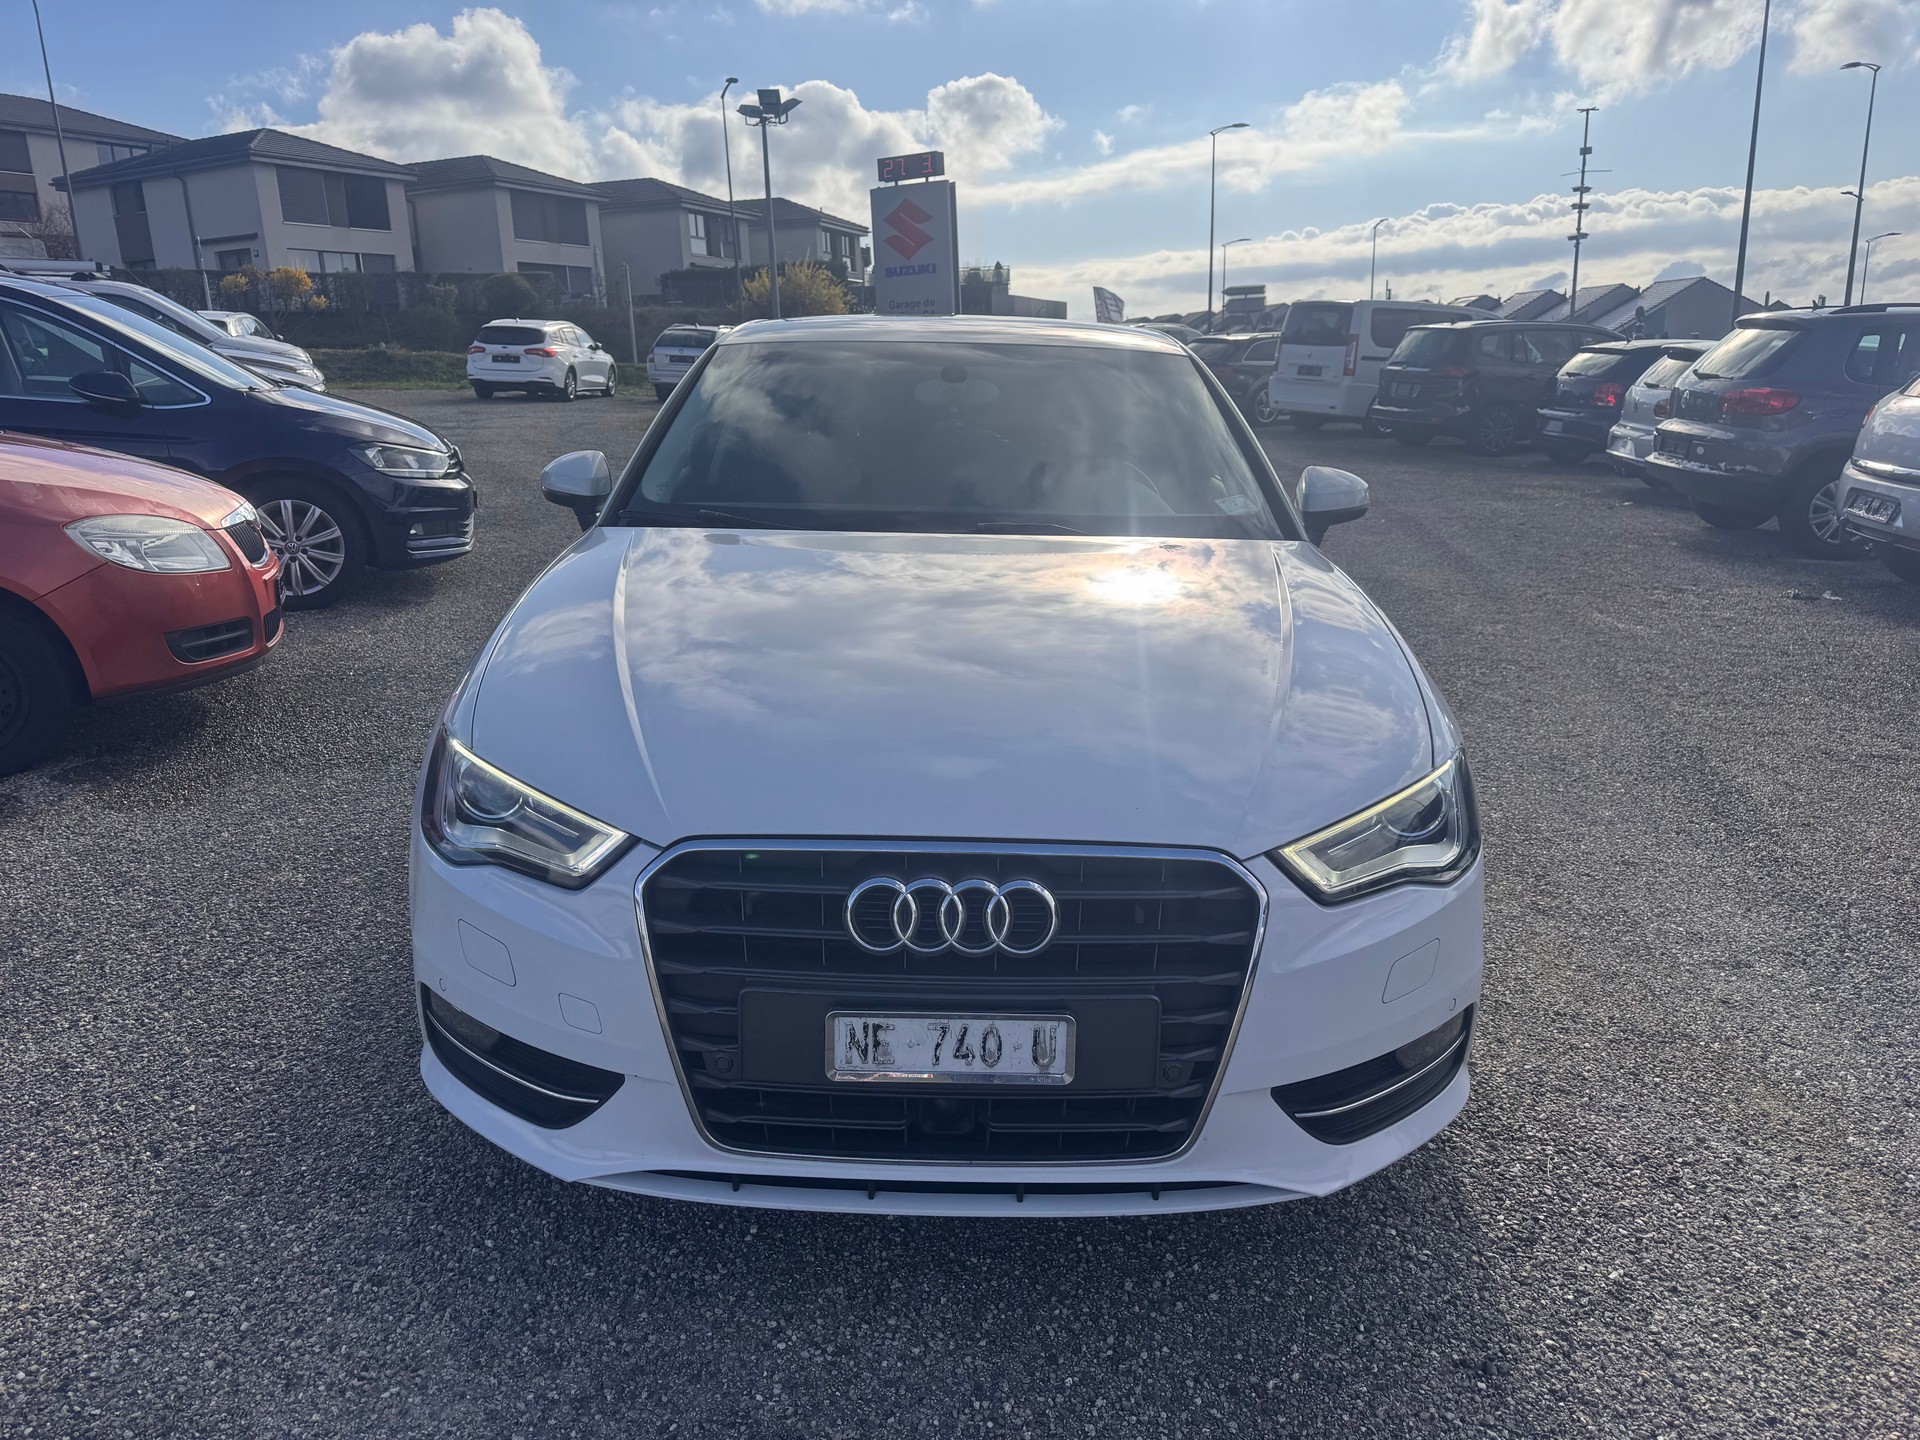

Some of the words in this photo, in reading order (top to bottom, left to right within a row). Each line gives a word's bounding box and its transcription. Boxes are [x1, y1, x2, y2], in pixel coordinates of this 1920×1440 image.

[885, 263, 937, 278] SUZUKI
[888, 299, 921, 311] Garage
[923, 297, 936, 308] de
[844, 1021, 896, 1065] NE
[927, 1022, 1003, 1068] 740
[1031, 1024, 1057, 1069] U
